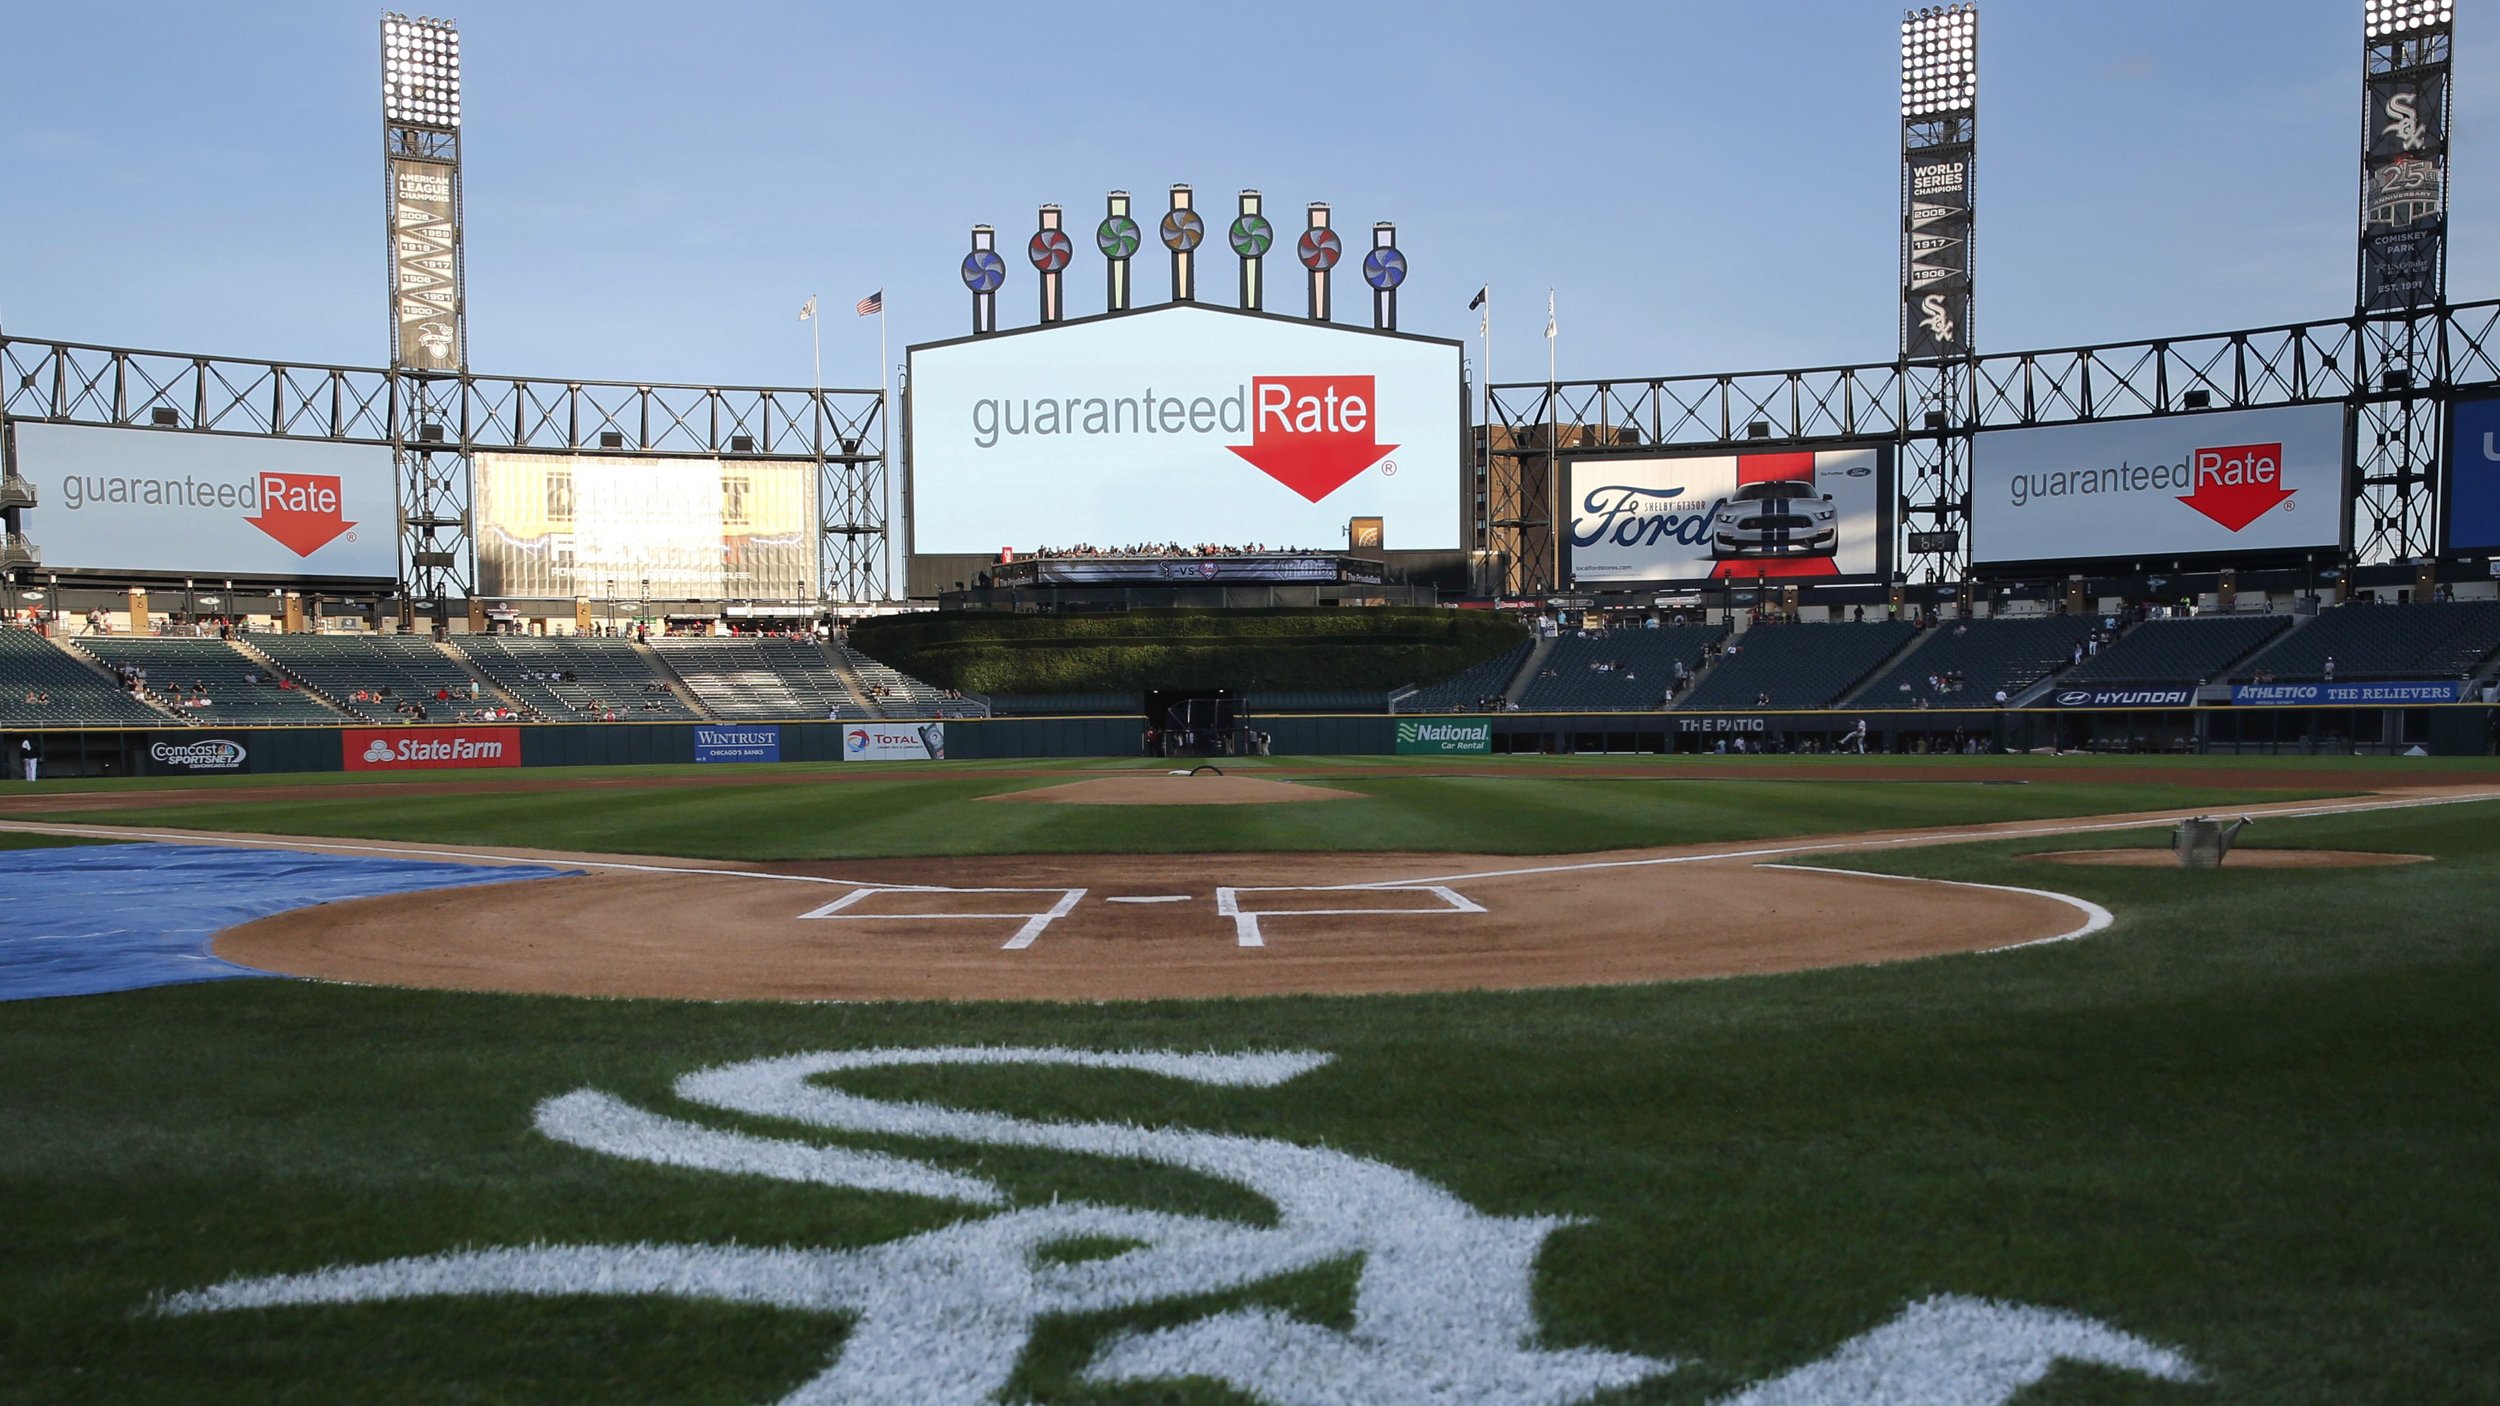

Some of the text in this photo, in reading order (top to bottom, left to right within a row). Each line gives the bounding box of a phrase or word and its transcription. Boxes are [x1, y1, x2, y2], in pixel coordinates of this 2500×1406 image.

[1913, 162, 1963, 178] WORLD
[399, 173, 449, 185] AMERICAN
[1914, 173, 1963, 188] SERIES
[2382, 162, 2425, 193] 25
[399, 181, 449, 195] LEAGUE
[1914, 184, 1963, 196] CHAMPIONS
[399, 192, 449, 202] CHAMPIONS
[2374, 191, 2431, 204] ANNIVERSARY
[400, 212, 429, 221] 2005
[1914, 208, 1945, 218] 2005
[422, 229, 450, 238] 1959
[2375, 231, 2427, 245] COMISKEY
[1914, 240, 1945, 249] 1917
[2387, 244, 2415, 254] PARK
[422, 261, 450, 269] 1917
[1914, 270, 1945, 279] 1906
[2378, 281, 2422, 293] EST. 1991
[423, 293, 451, 301] 1901
[404, 307, 433, 315] 1900
[972, 384, 1368, 448] guaranteed Rate
[2011, 452, 2275, 507] guaranteed Rate
[63, 474, 337, 514] guaranteed Rate
[1644, 500, 1706, 512] SHELBY GT350R
[1571, 485, 1728, 547] Ford
[1179, 568, 1195, 576] VS
[2094, 691, 2187, 704] HYUNDAI
[2237, 685, 2318, 699] ATHLETICO
[2327, 687, 2451, 700] THE RELIEVERS
[1679, 719, 1764, 732] THE PATIO
[698, 730, 776, 744] WINTRUST
[1417, 724, 1488, 741] National
[151, 742, 218, 761] Comcast
[397, 738, 503, 761] State Farm
[1441, 741, 1485, 750] Car Rental
[168, 754, 235, 765] SPORTSNET
